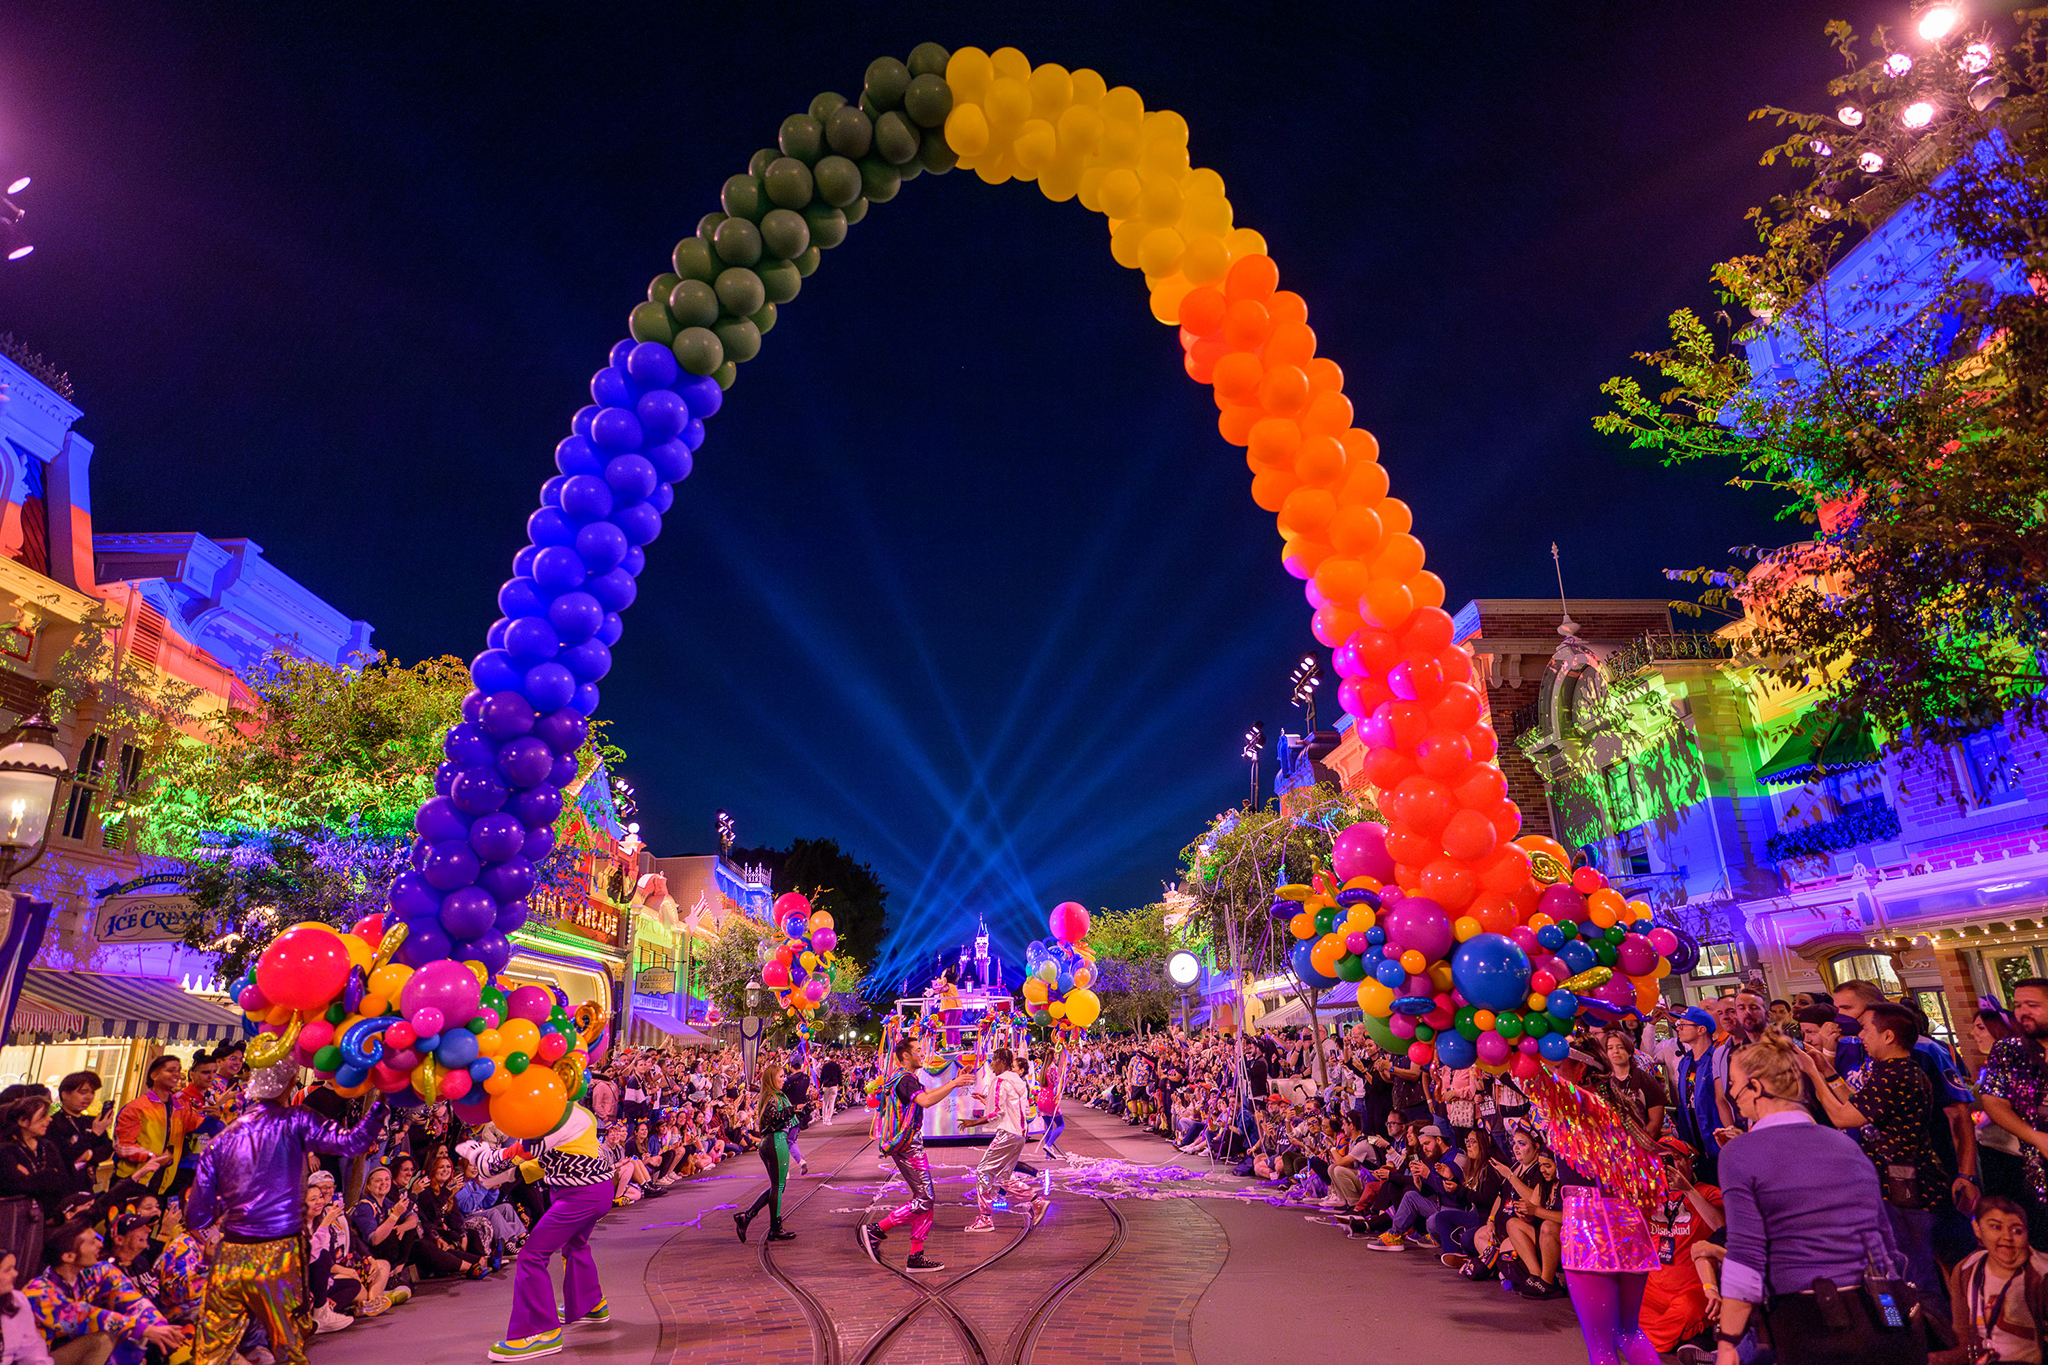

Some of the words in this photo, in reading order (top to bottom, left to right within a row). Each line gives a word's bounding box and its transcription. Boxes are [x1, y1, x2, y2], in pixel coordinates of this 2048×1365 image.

[124, 904, 156, 914] HAND
[575, 903, 618, 937] ARCADE
[105, 914, 137, 937] ICE
[140, 910, 203, 934] CREAM
